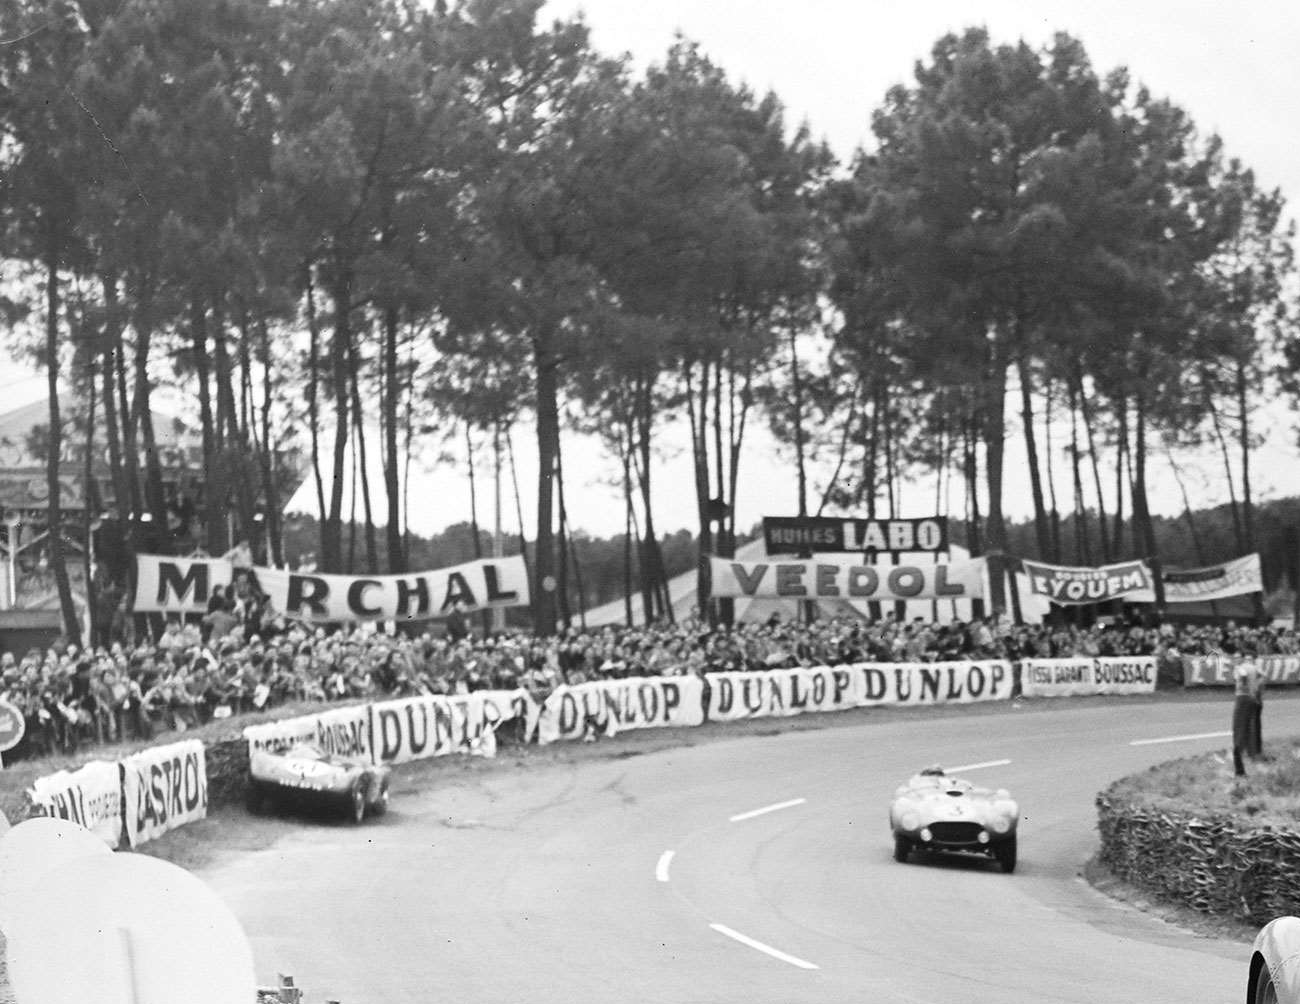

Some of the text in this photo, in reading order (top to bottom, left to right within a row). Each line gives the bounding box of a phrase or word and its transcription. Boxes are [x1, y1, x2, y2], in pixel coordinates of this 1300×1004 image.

[842, 520, 942, 551] LABO
[729, 562, 966, 598] VEEDOL
[862, 664, 1006, 701] DUNLOP
[1093, 658, 1154, 685] BOUSSAC
[559, 682, 681, 735] DUNLOP
[717, 670, 850, 713] DUNLOP
